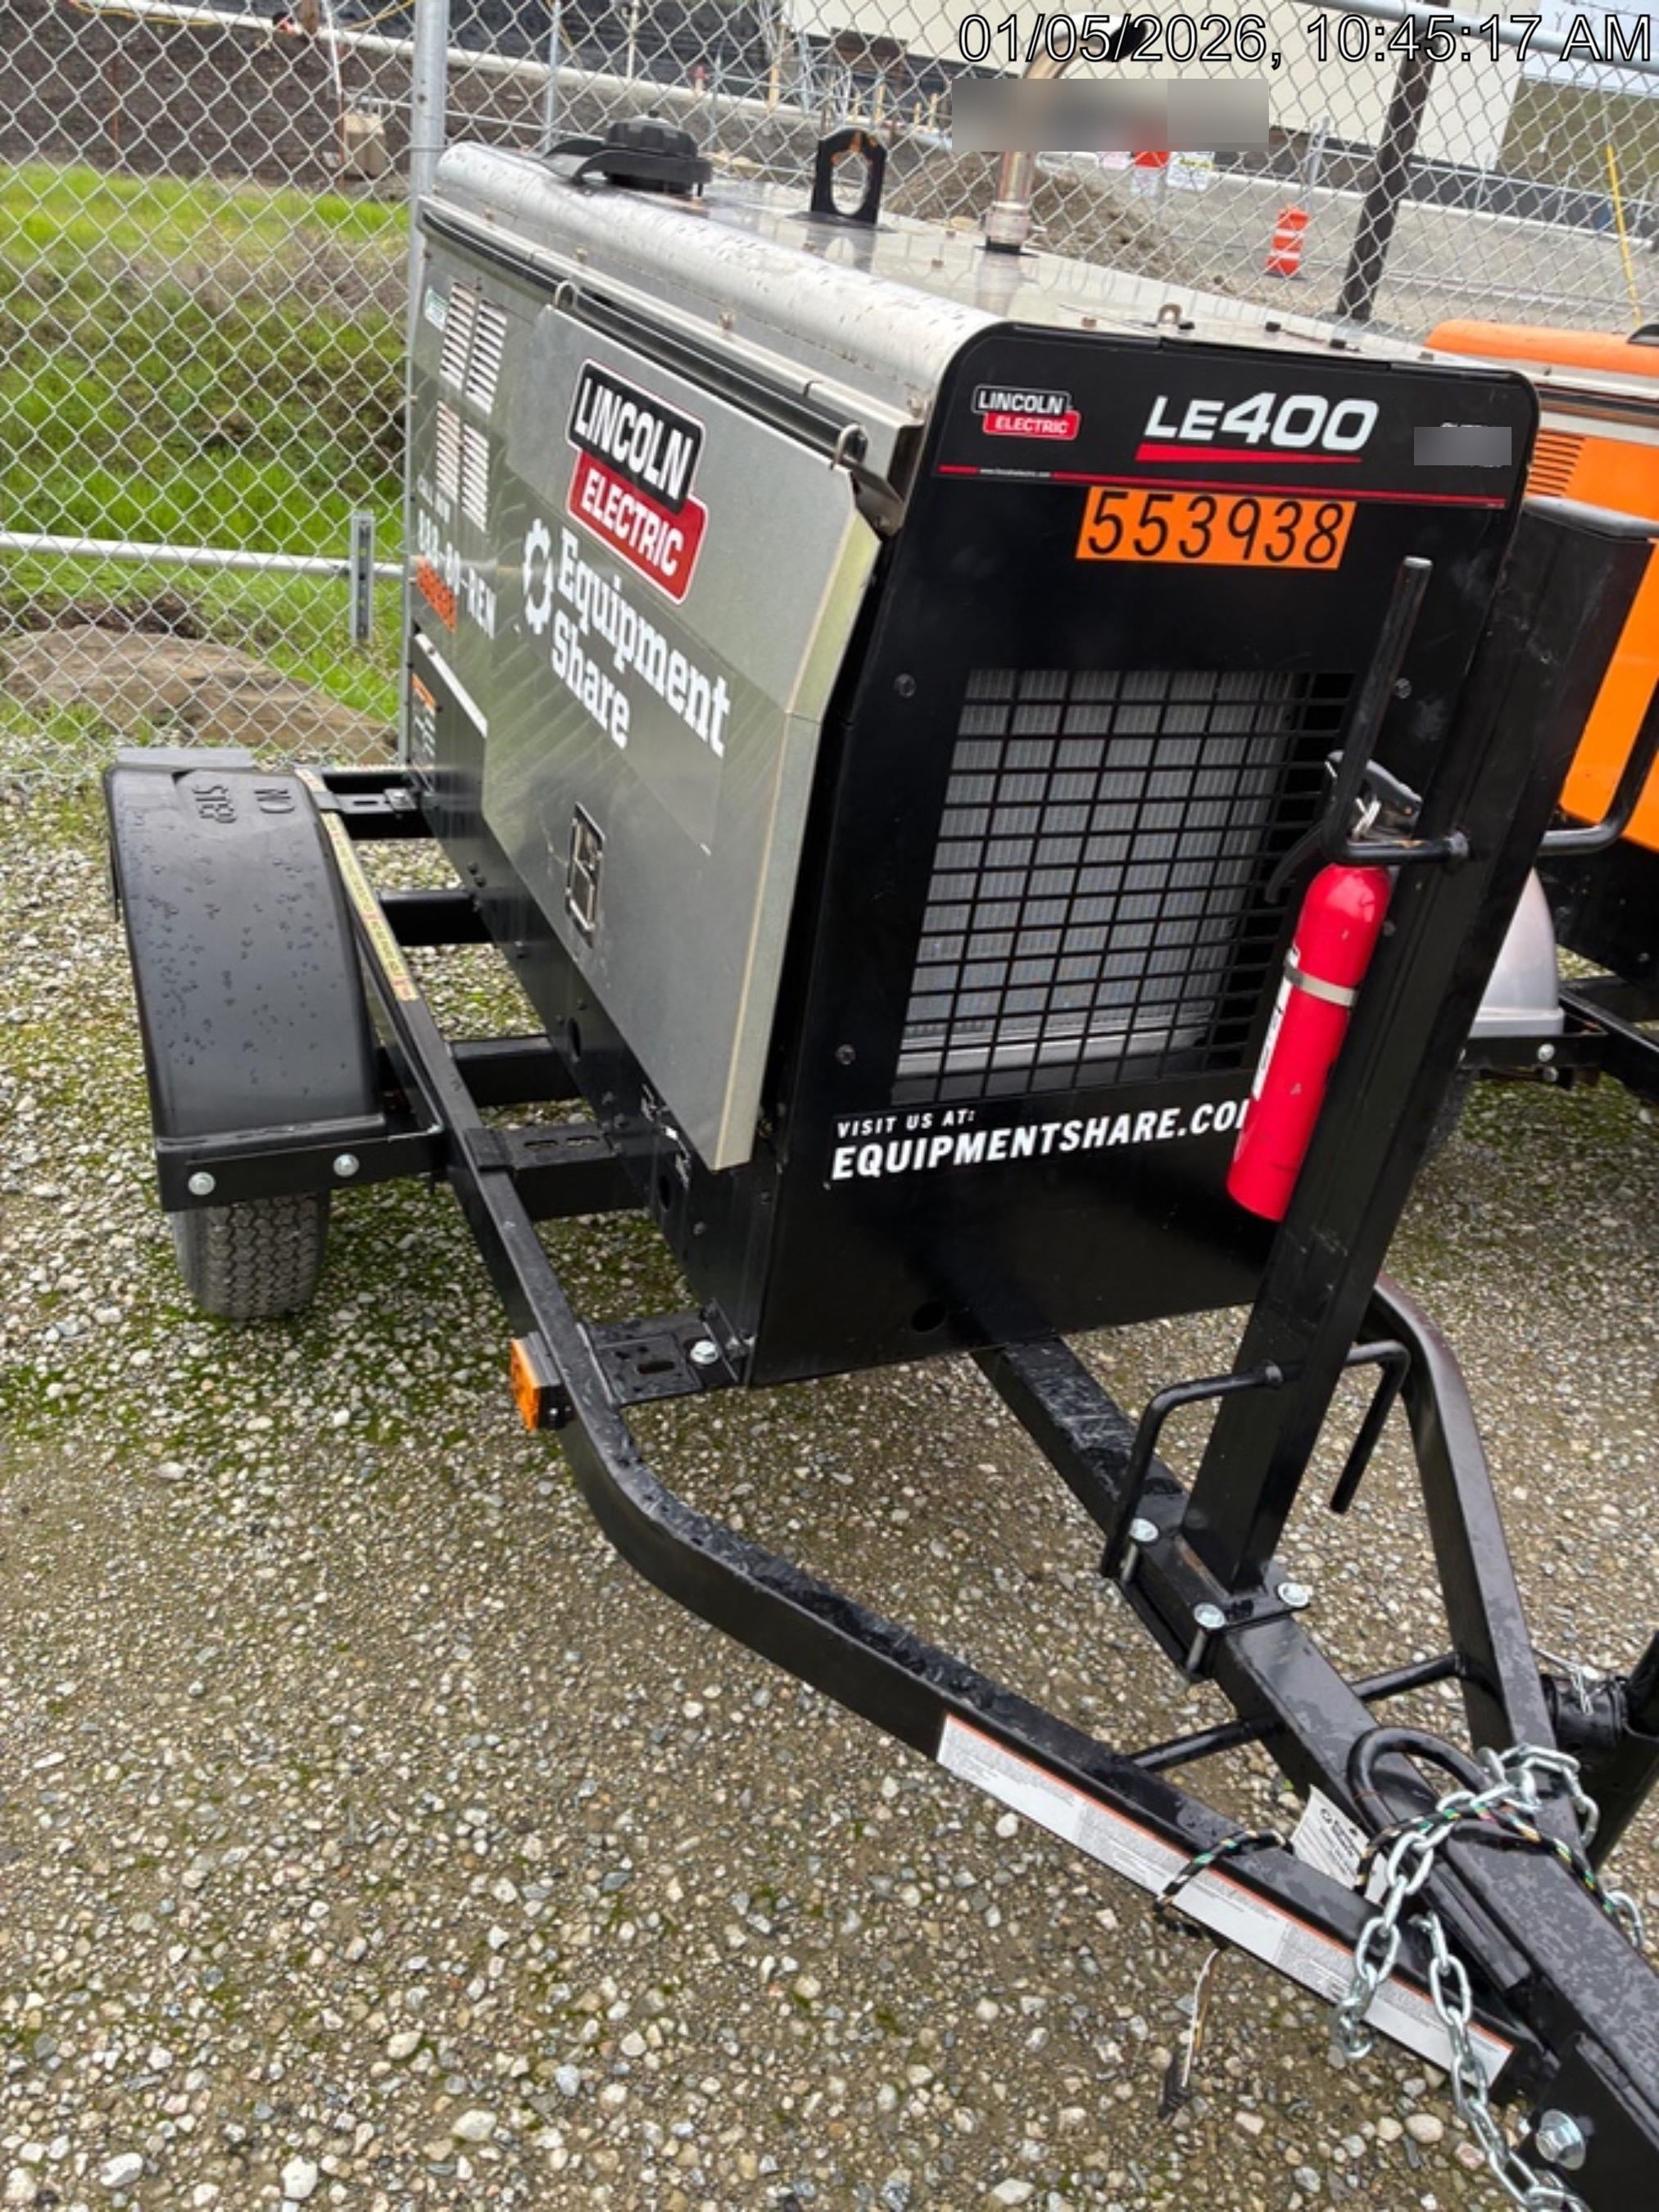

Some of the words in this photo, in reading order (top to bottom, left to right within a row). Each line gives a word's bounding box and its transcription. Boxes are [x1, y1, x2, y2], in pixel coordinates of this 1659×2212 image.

[978, 390, 1064, 415] LINCOLN
[995, 415, 1068, 434] ELECTRIC
[1145, 392, 1379, 452] LE400
[574, 378, 694, 500] LINCOLN
[580, 469, 685, 577] ELECTRIC
[1086, 493, 1344, 564] 553938
[558, 527, 732, 759] Equipment
[551, 608, 631, 750] Share
[836, 1115, 897, 1139] VISIT
[905, 1111, 934, 1131] US
[941, 1108, 977, 1128] AT:
